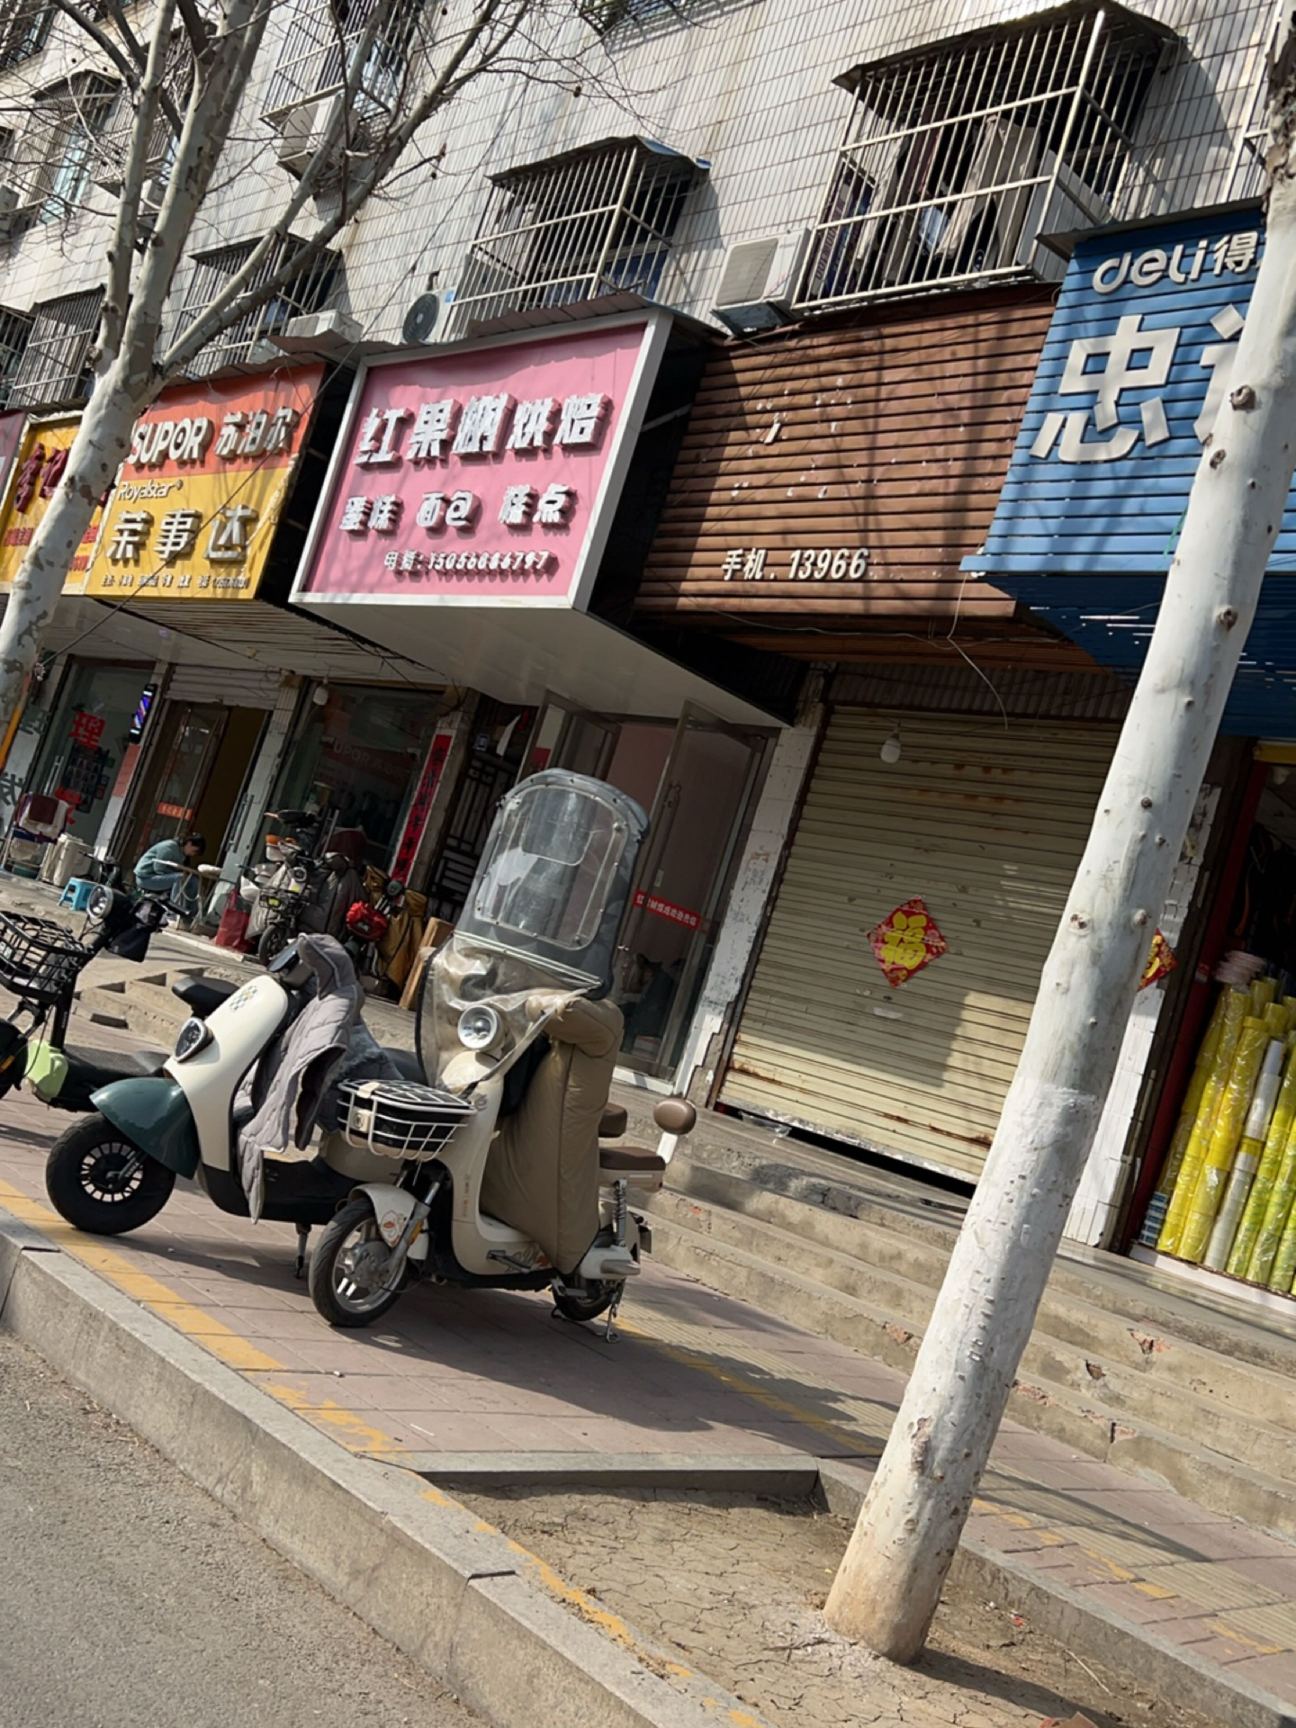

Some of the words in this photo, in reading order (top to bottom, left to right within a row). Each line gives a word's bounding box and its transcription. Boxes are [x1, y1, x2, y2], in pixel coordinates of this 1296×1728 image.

[1092, 239, 1208, 294] deli
[1213, 231, 1263, 276] 得
[127, 416, 211, 466] SUPOR
[215, 407, 298, 457] 苏泊尔
[107, 504, 259, 561] 荣事达
[340, 494, 397, 531] 蛋糕
[416, 491, 476, 528] 面包
[786, 547, 870, 580] 13966
[880, 911, 927, 970] 福
